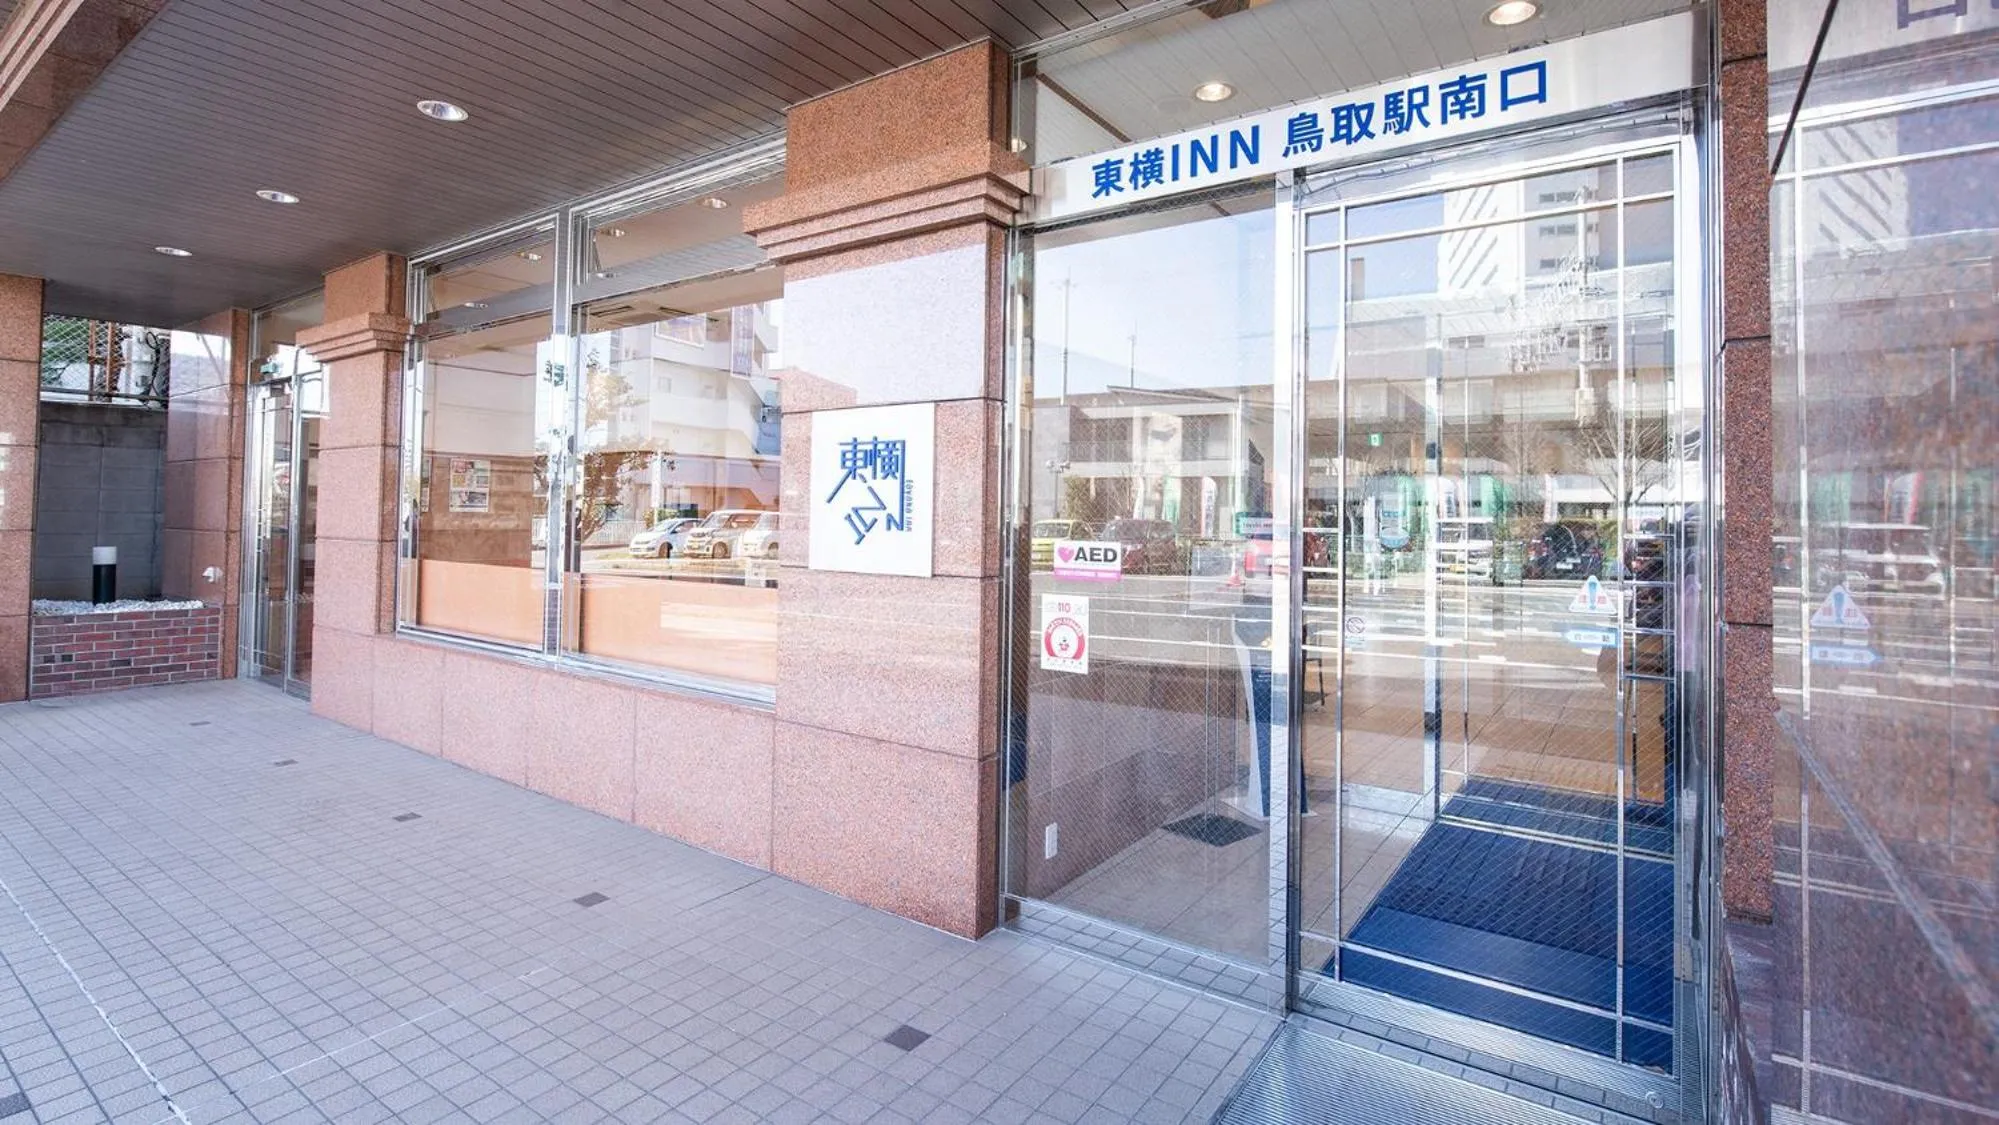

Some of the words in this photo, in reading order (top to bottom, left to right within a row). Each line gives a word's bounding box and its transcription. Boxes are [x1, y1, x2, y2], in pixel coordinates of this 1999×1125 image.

[1092, 125, 1259, 198] 東横INN
[1282, 60, 1546, 158] 鳥取駅南口
[1074, 546, 1118, 563] AED
